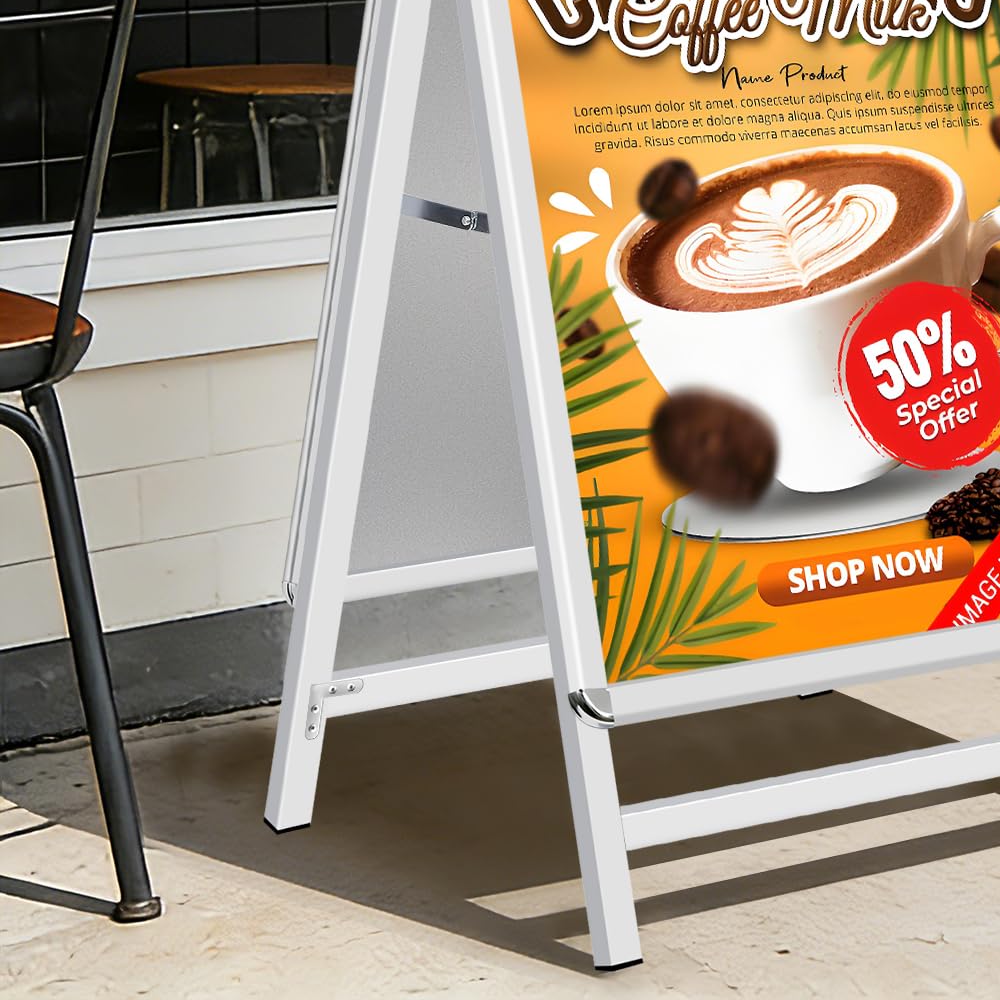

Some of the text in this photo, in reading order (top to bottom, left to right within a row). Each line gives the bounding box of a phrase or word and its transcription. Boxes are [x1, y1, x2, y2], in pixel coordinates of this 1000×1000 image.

[720, 62, 848, 90] Name Product
[573, 105, 613, 118] Lorem
[615, 103, 651, 118] ipsum
[654, 100, 685, 114] dolor
[689, 98, 703, 111] sit
[740, 92, 806, 108] consectetur
[809, 89, 863, 108] adipiscing
[887, 87, 900, 99] do
[904, 83, 949, 98] eiusmod
[951, 84, 990, 99] tempor
[637, 120, 649, 131] ut
[651, 118, 689, 131] labore
[692, 117, 703, 128] et
[707, 114, 744, 127] dolore
[746, 113, 785, 126] magna
[787, 108, 824, 123] aliqua.
[826, 106, 852, 120] Quis
[855, 105, 887, 119] ipsum
[890, 101, 954, 116] suspendisse
[957, 99, 995, 112] ultrices
[594, 137, 642, 153] gravida.
[644, 135, 675, 148] Risus
[677, 131, 736, 145] commodo
[739, 129, 778, 142] viverra
[780, 127, 836, 139] maecenas
[838, 123, 893, 135] accumsan
[895, 119, 922, 131] lacus
[925, 117, 939, 129] vel
[862, 310, 977, 400] 50%
[896, 368, 983, 426] Special
[919, 401, 978, 440] Offer
[787, 546, 943, 594] SHOP NOW
